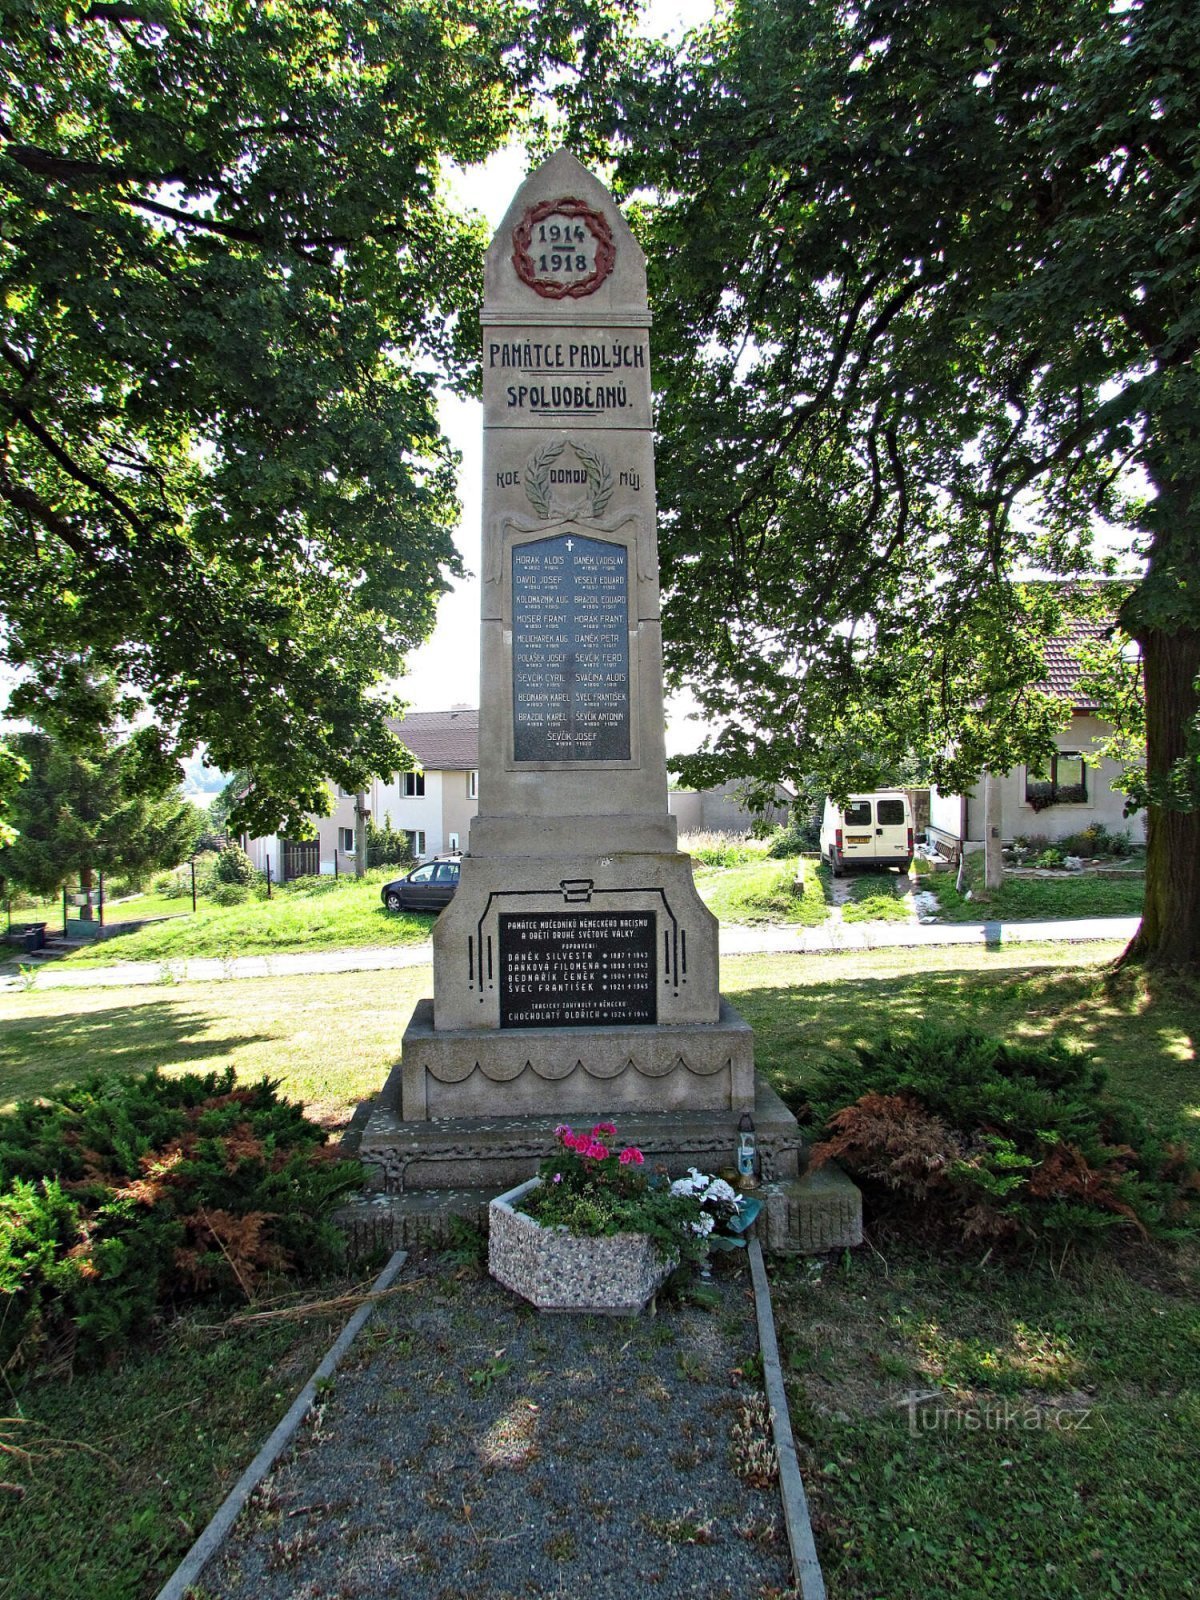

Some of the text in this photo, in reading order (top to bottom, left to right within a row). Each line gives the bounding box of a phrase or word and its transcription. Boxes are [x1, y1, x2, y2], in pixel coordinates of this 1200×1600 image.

[538, 225, 585, 243] 1914
[538, 255, 587, 272] 1918
[489, 339, 645, 368] PAMÁTCE PADLÝCH
[540, 575, 563, 584] JOSEF
[574, 732, 598, 741] JOSEF
[507, 919, 538, 930] PAMÁTCE
[521, 931, 526, 940] A
[546, 952, 593, 961] SILVESTR
